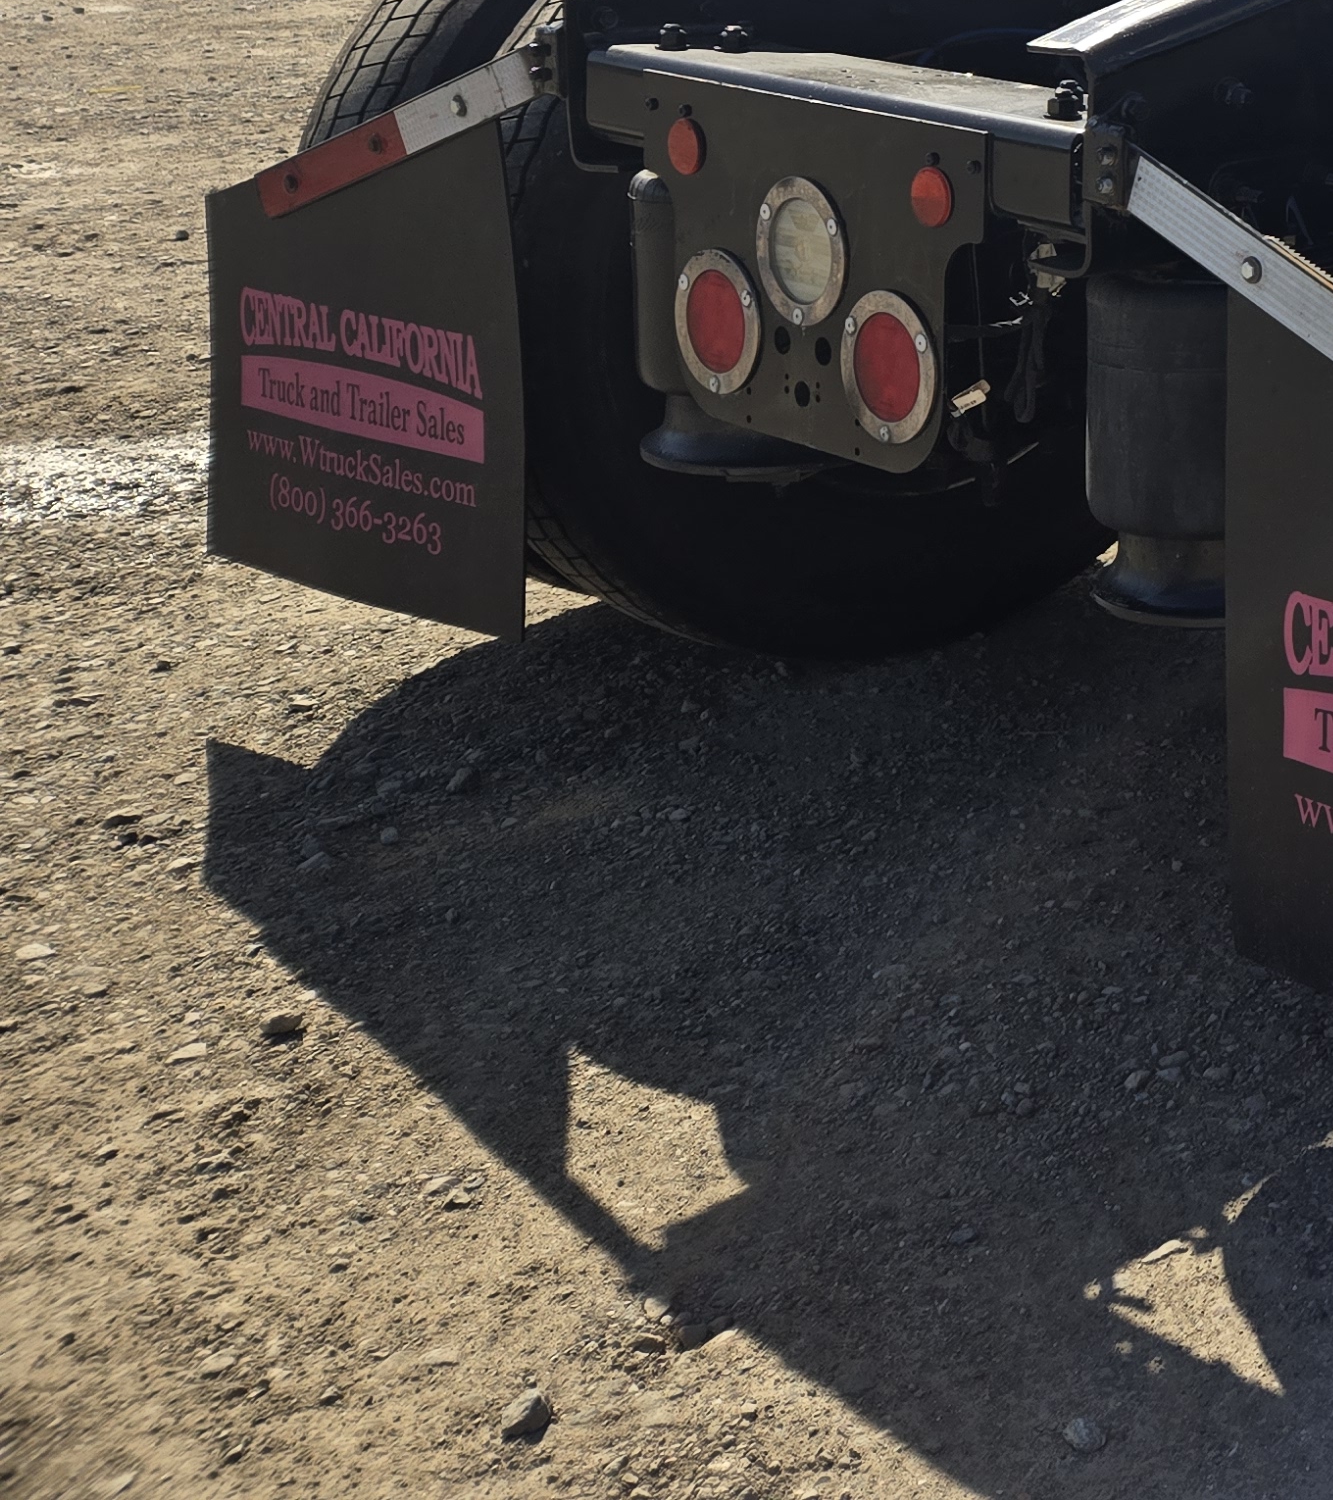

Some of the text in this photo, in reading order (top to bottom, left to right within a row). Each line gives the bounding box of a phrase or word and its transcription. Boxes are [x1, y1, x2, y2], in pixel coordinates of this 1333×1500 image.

[240, 286, 483, 400] CENTRAL CALIFORNIA
[258, 367, 465, 446] Truck and Trailer Sales
[247, 428, 477, 508] www.WtruckSales.com
[270, 472, 442, 555] (800) 366-3263
